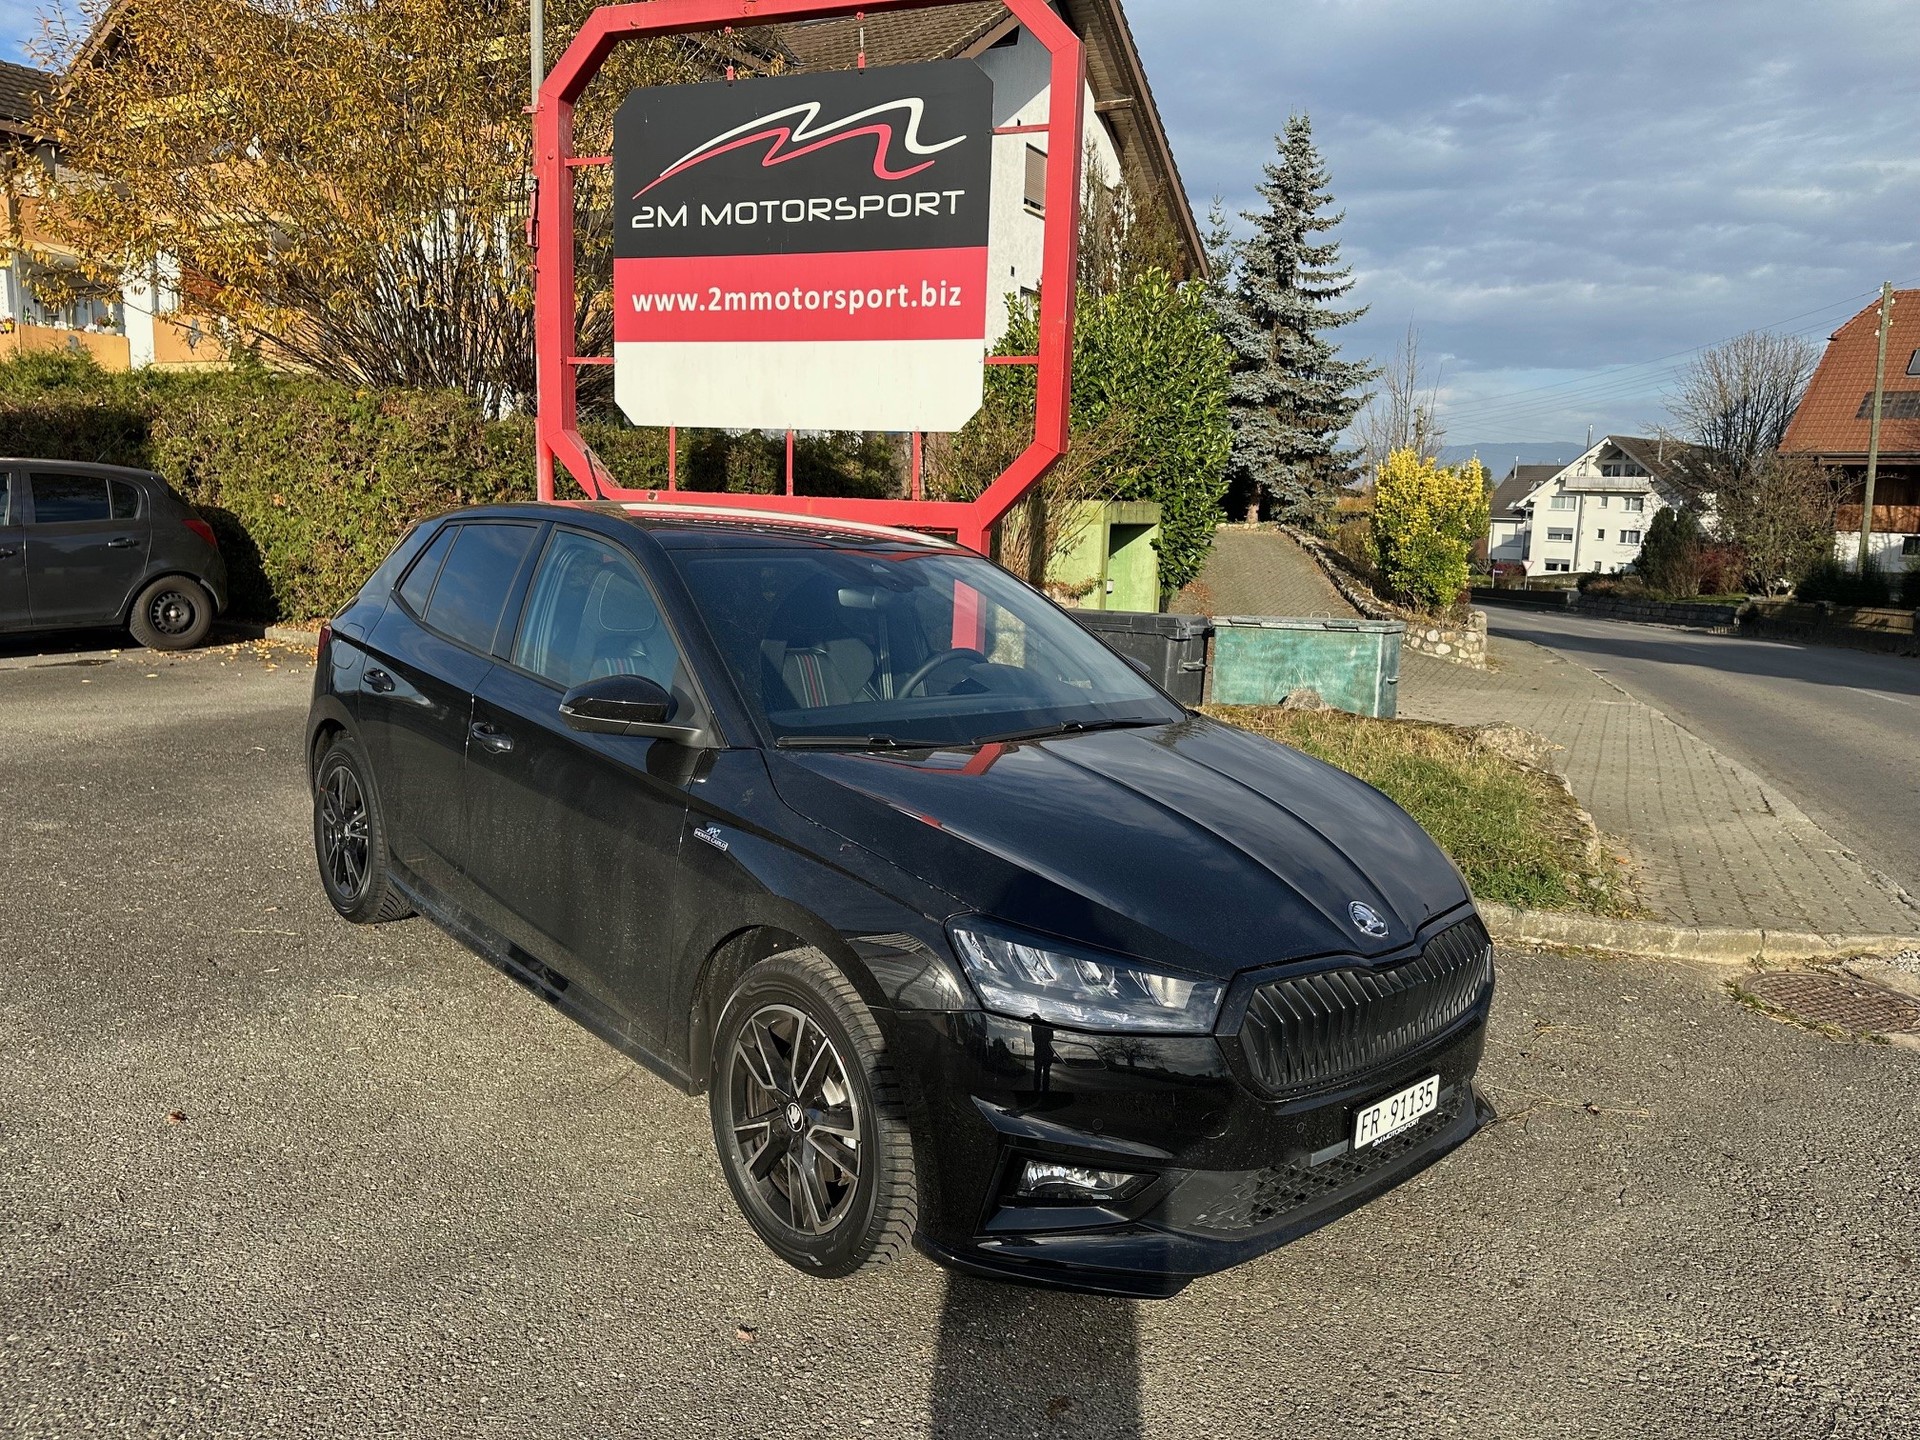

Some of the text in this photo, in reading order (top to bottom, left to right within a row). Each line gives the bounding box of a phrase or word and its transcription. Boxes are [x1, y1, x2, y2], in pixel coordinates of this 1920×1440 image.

[631, 190, 965, 229] 2M MOTORSPORT
[632, 280, 962, 315] www.2mmotorsport.biz
